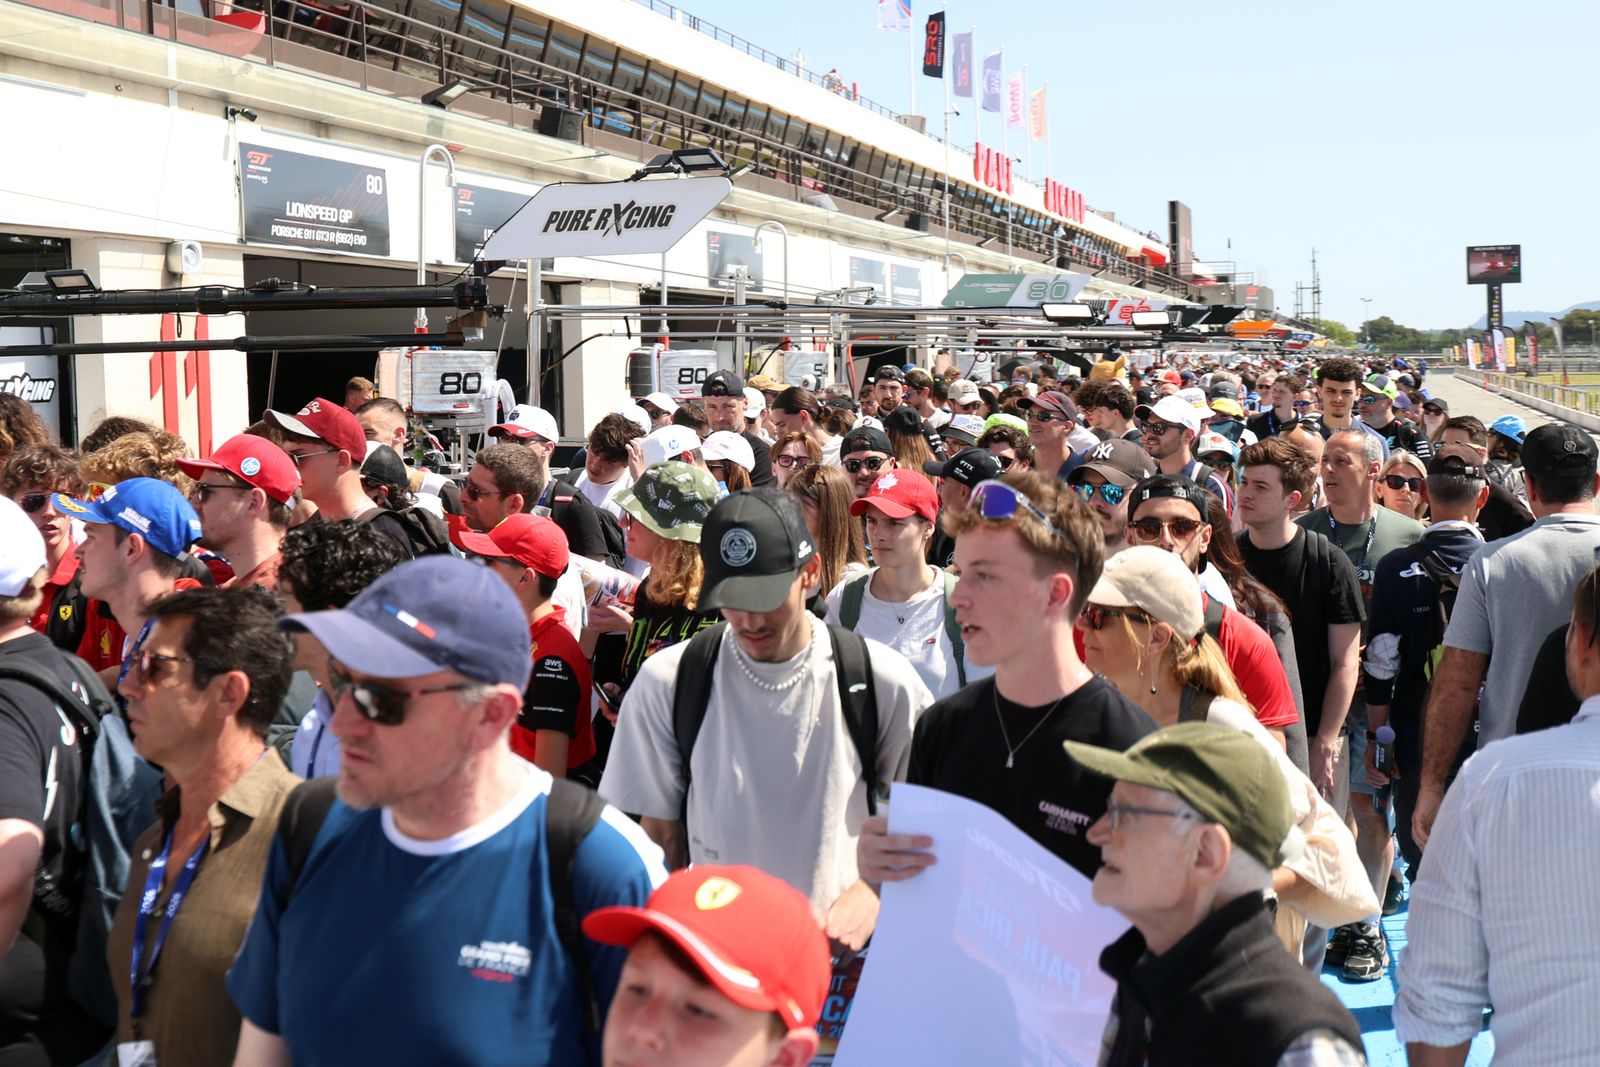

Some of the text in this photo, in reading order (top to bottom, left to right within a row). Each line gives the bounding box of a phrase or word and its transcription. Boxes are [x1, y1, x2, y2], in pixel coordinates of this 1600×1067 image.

[925, 21, 939, 66] SRO
[366, 174, 382, 195] 80
[286, 200, 353, 224] LIONSPEED GP
[542, 209, 596, 233] PURE
[271, 224, 303, 239] PORSCHE
[303, 228, 316, 241] 911
[316, 229, 330, 242] GT3
[330, 231, 335, 242] R
[353, 233, 367, 246] EVO
[1027, 280, 1072, 301] 80
[439, 372, 482, 395] 80
[678, 368, 708, 384] 80
[544, 659, 562, 669] aws
